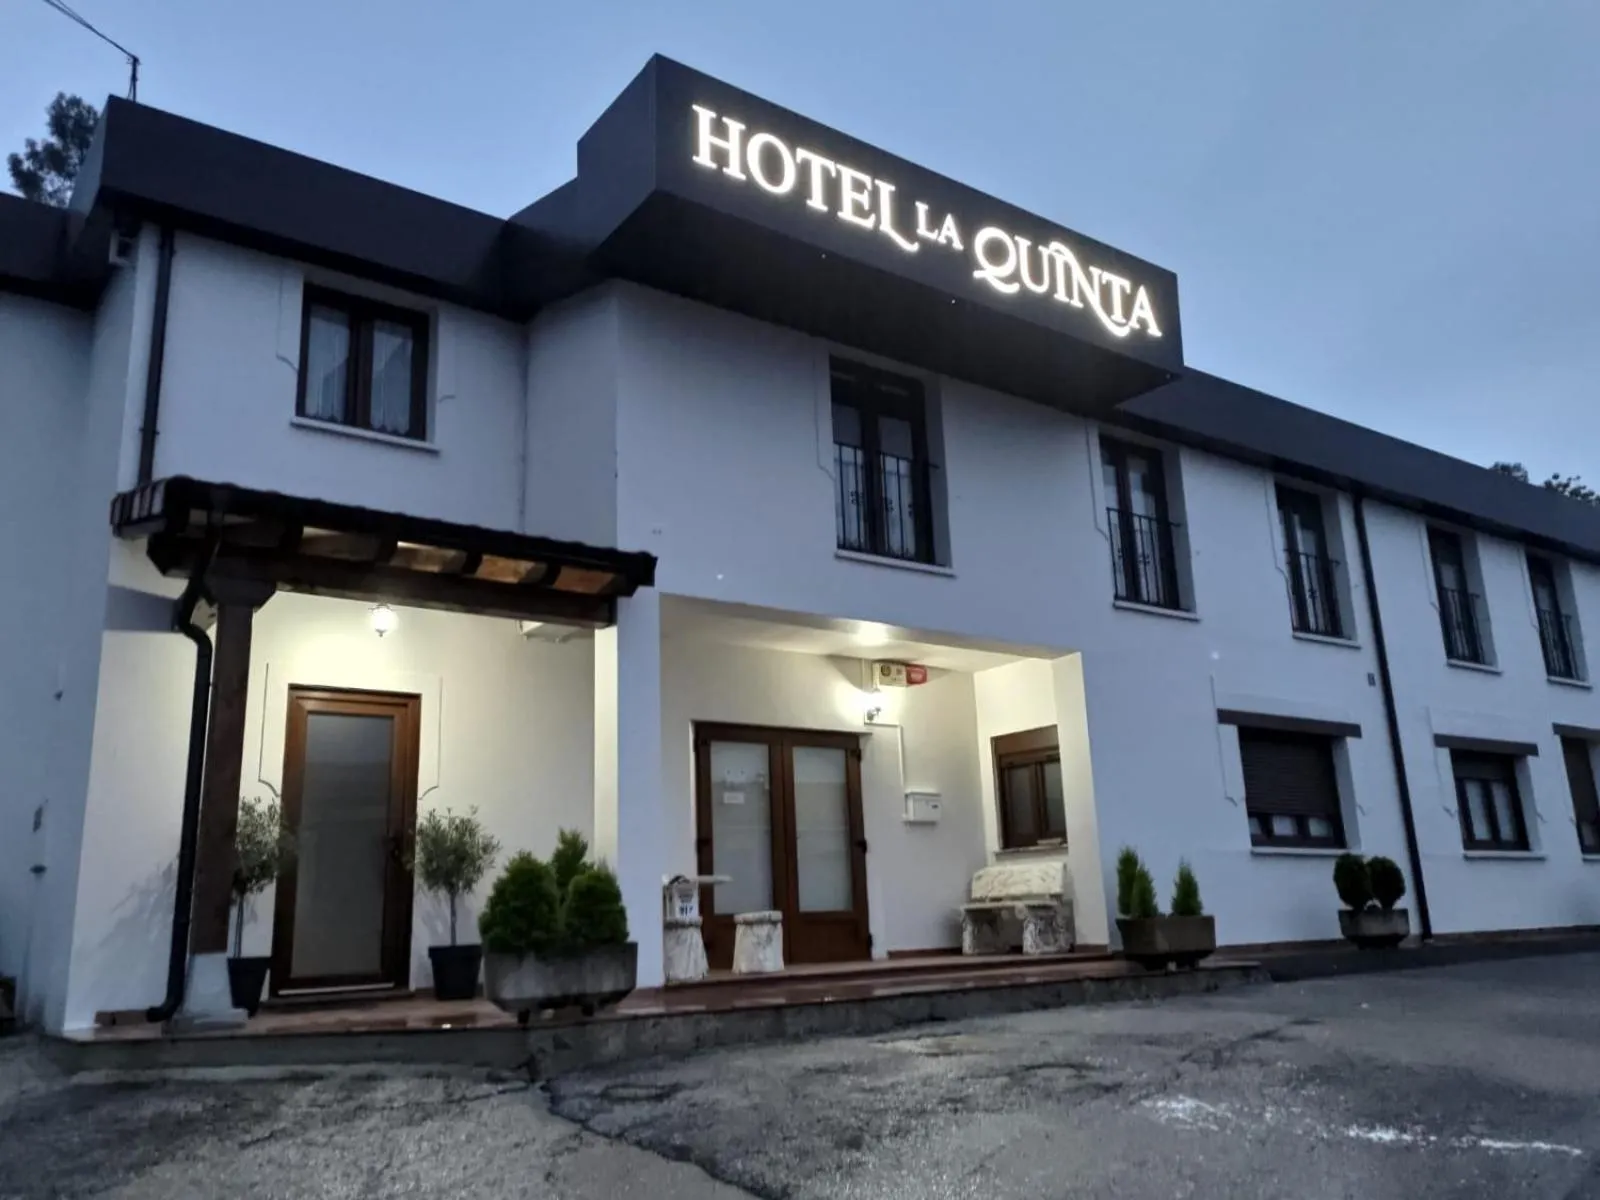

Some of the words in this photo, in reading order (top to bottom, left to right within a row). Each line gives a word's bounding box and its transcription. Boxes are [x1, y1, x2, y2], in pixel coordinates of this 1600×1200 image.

[692, 104, 919, 253] HOTEL
[915, 201, 964, 251] LA
[973, 226, 1163, 338] QUINTA
